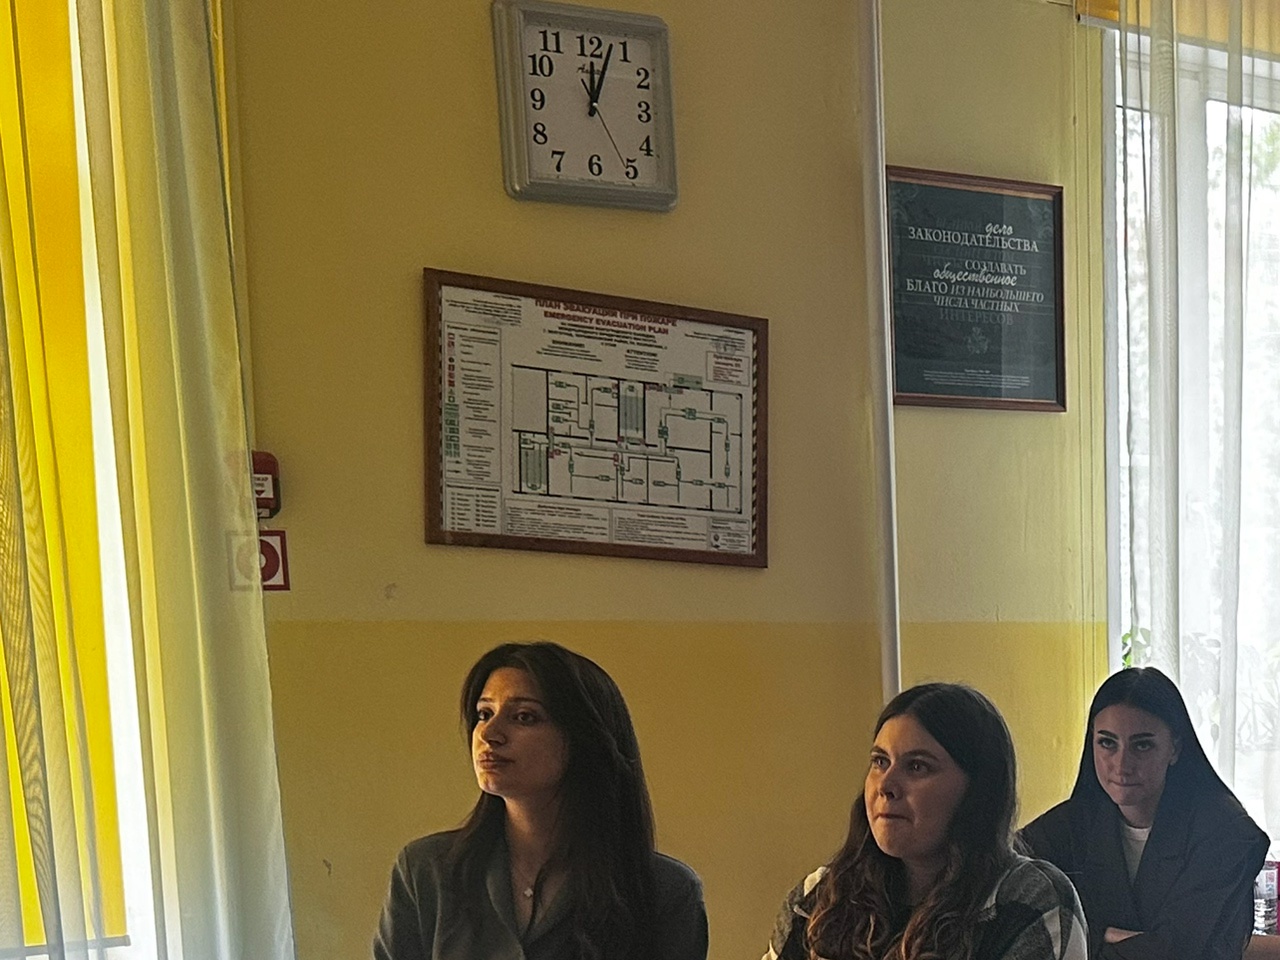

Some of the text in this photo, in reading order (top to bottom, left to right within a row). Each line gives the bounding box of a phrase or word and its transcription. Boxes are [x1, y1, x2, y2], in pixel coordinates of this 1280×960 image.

[539, 30, 564, 54] 11
[576, 34, 603, 59] 12
[619, 41, 631, 63] 1
[528, 54, 554, 77] 10
[636, 67, 650, 90] 2
[530, 88, 545, 110] 9
[637, 101, 652, 123] 3
[533, 122, 548, 145] 8
[639, 135, 654, 157] 4
[551, 150, 565, 172] 7
[588, 154, 603, 176] 6
[625, 158, 638, 179] 5
[908, 226, 1039, 253] ЗАКОНОДАТЕЛЬСТВА
[985, 222, 1013, 238] дело
[933, 262, 1018, 287] общественное
[965, 260, 1027, 275] СОЗДАВАТЬ
[906, 278, 1045, 303] БЛАГО ИЗ НАИБОЛЬШЕГО
[934, 296, 1020, 313] ЧИСЛА ЧАСТНЫХ
